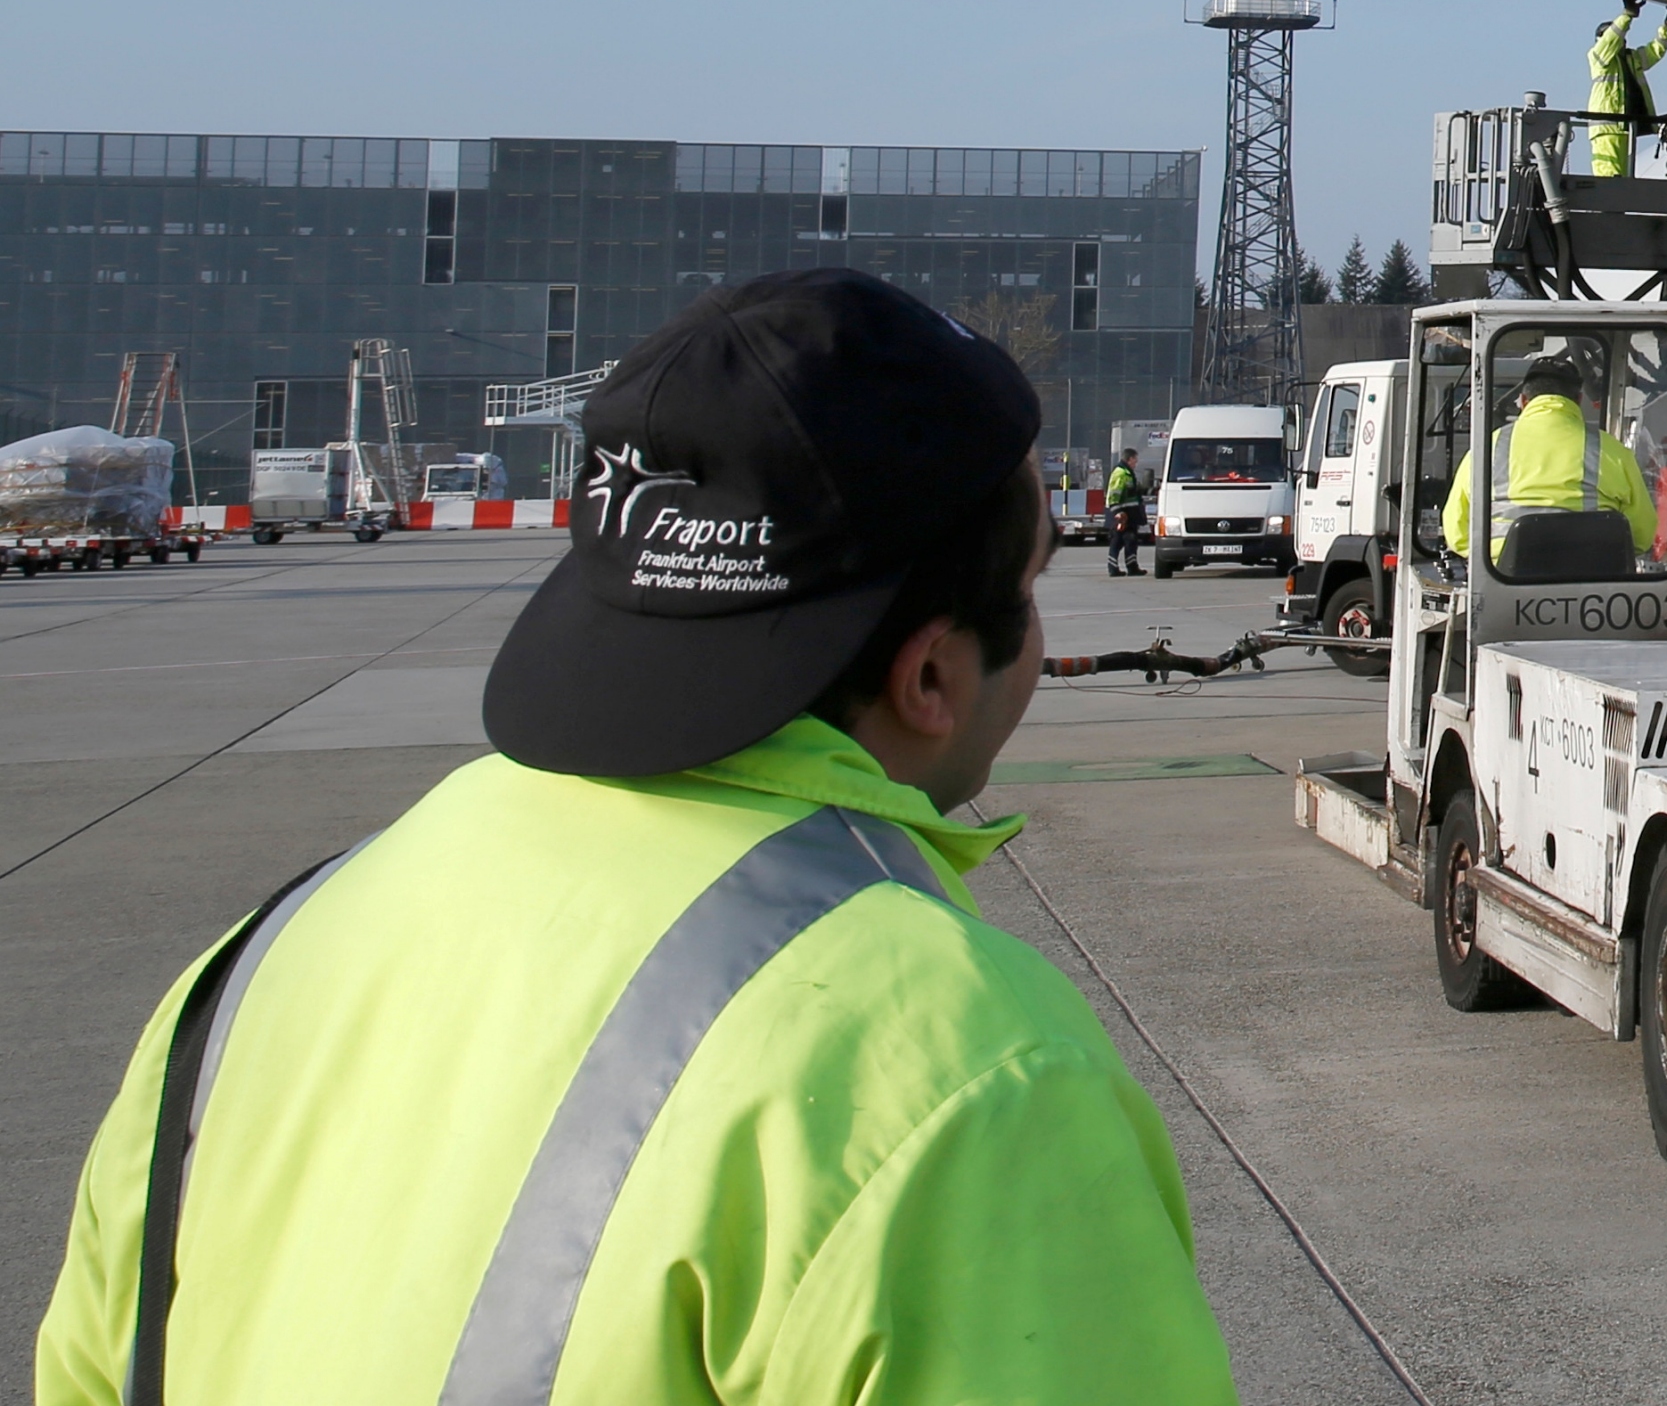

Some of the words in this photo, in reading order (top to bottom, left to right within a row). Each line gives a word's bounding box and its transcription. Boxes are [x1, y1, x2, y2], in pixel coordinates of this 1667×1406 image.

[644, 507, 773, 552] Fraport
[638, 550, 704, 571] Frankfurt
[705, 553, 765, 575] Airport
[1302, 543, 1315, 558] 229
[1528, 720, 1539, 794] 4
